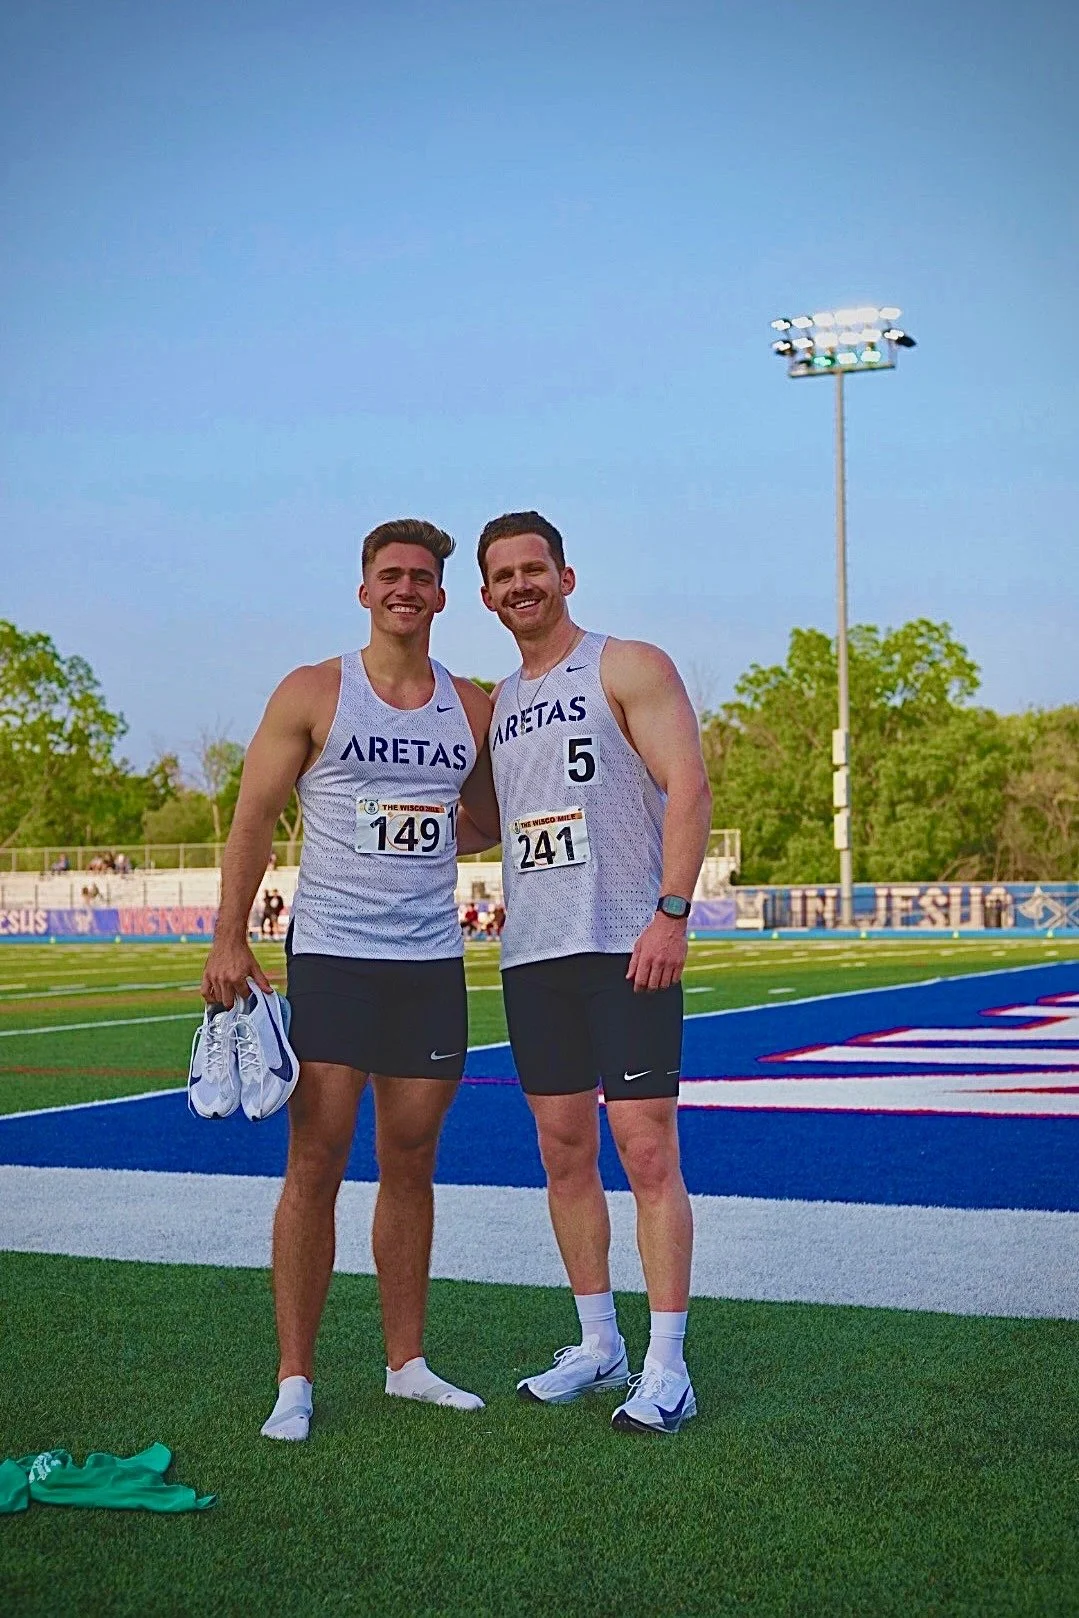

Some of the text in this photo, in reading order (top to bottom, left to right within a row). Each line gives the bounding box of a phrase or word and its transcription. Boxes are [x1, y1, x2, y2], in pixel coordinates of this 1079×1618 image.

[493, 696, 586, 752] ARETAS
[340, 735, 467, 771] ARETAS
[568, 738, 595, 783] 5
[369, 816, 440, 853] 149
[521, 821, 532, 829] THE
[533, 816, 556, 827] WISCO
[557, 813, 576, 822] MILE
[518, 826, 575, 869] 241
